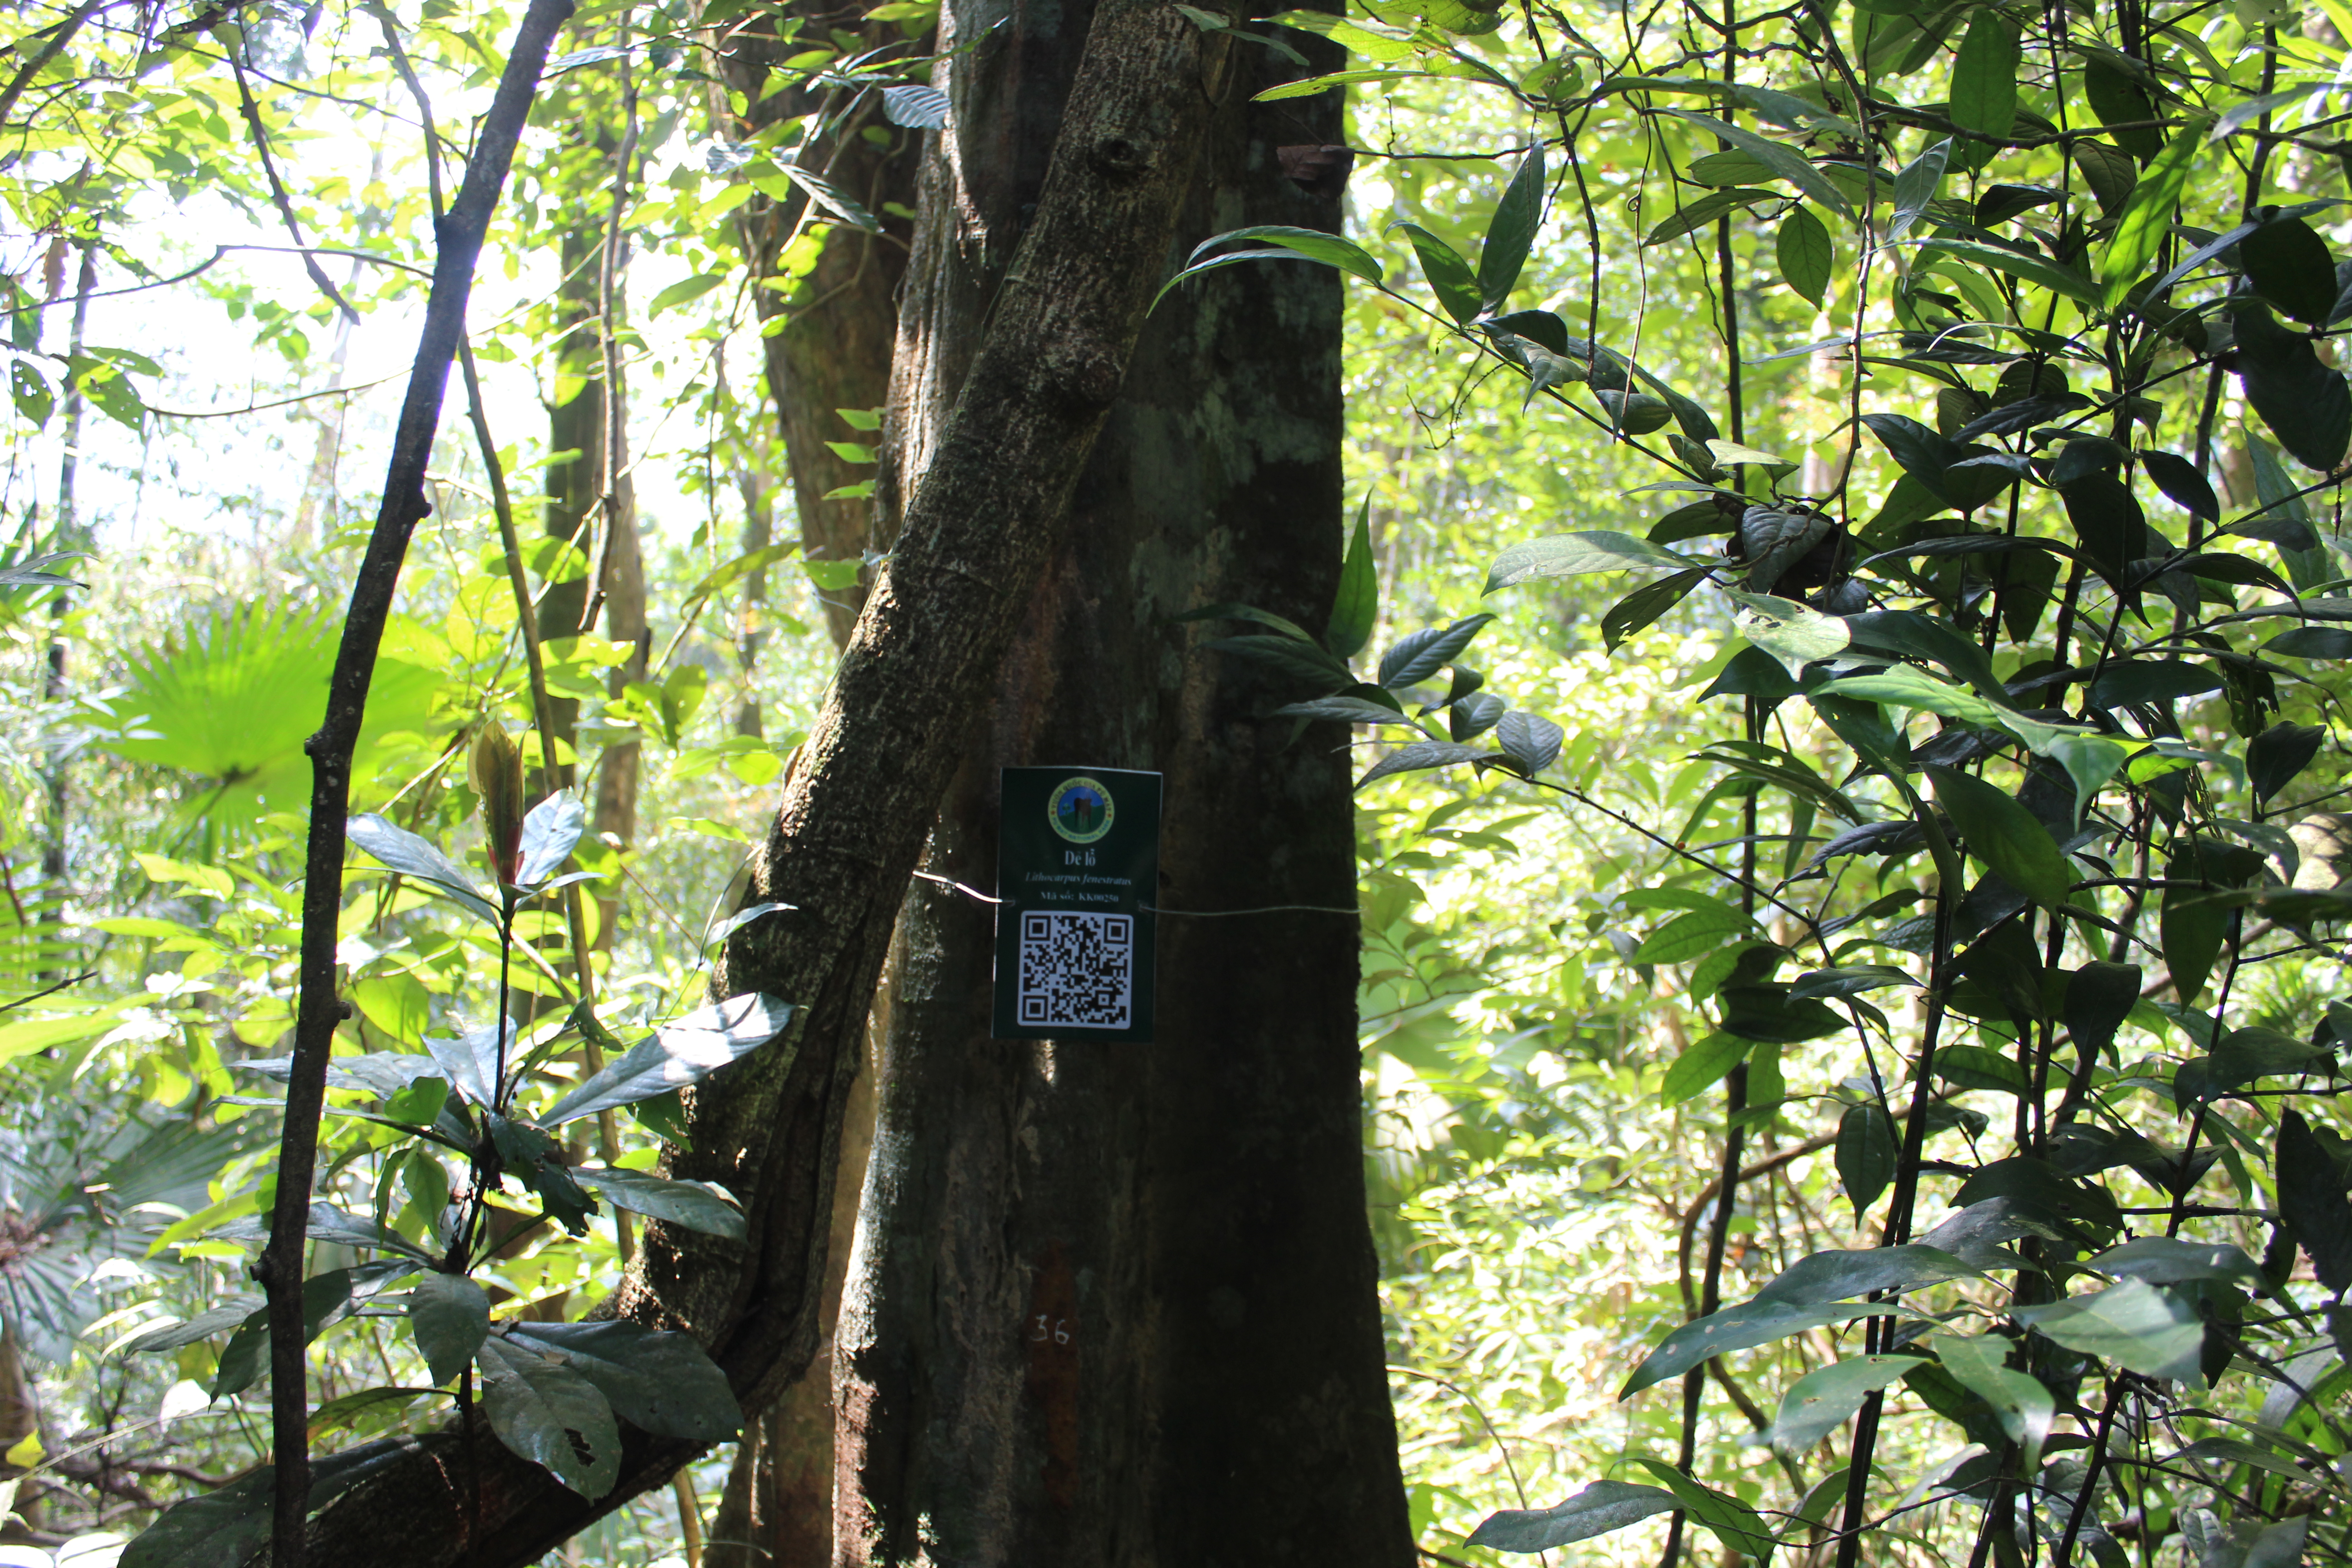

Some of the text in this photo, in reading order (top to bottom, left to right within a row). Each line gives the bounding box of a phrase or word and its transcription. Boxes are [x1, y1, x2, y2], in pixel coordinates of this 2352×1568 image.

[1025, 872, 1132, 886] Lithocarpus fenestratus
[1029, 1314, 1070, 1345] 36
